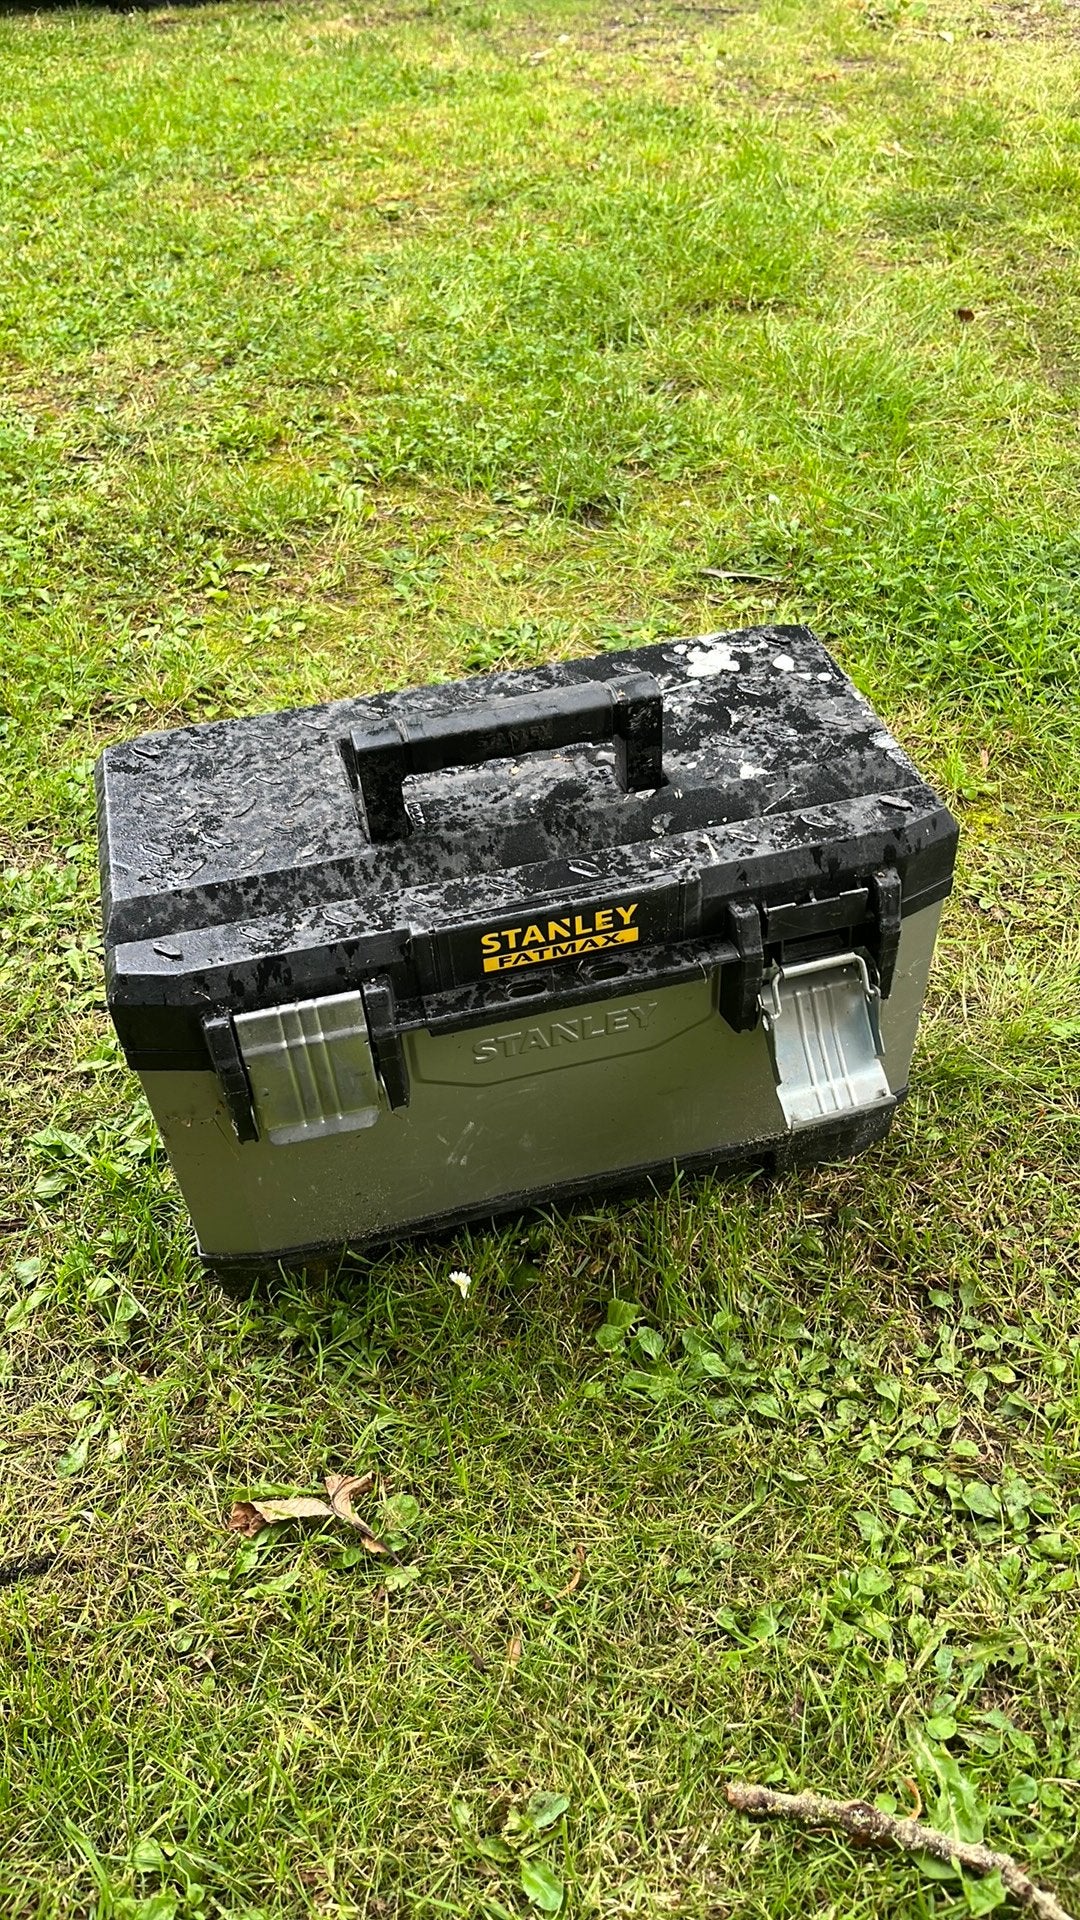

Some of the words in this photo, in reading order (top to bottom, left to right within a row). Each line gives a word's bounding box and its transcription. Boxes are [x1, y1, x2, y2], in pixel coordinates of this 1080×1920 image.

[481, 904, 638, 954] STANLEY
[498, 932, 621, 968] FATMAX
[472, 1001, 658, 1064] STANLEY
